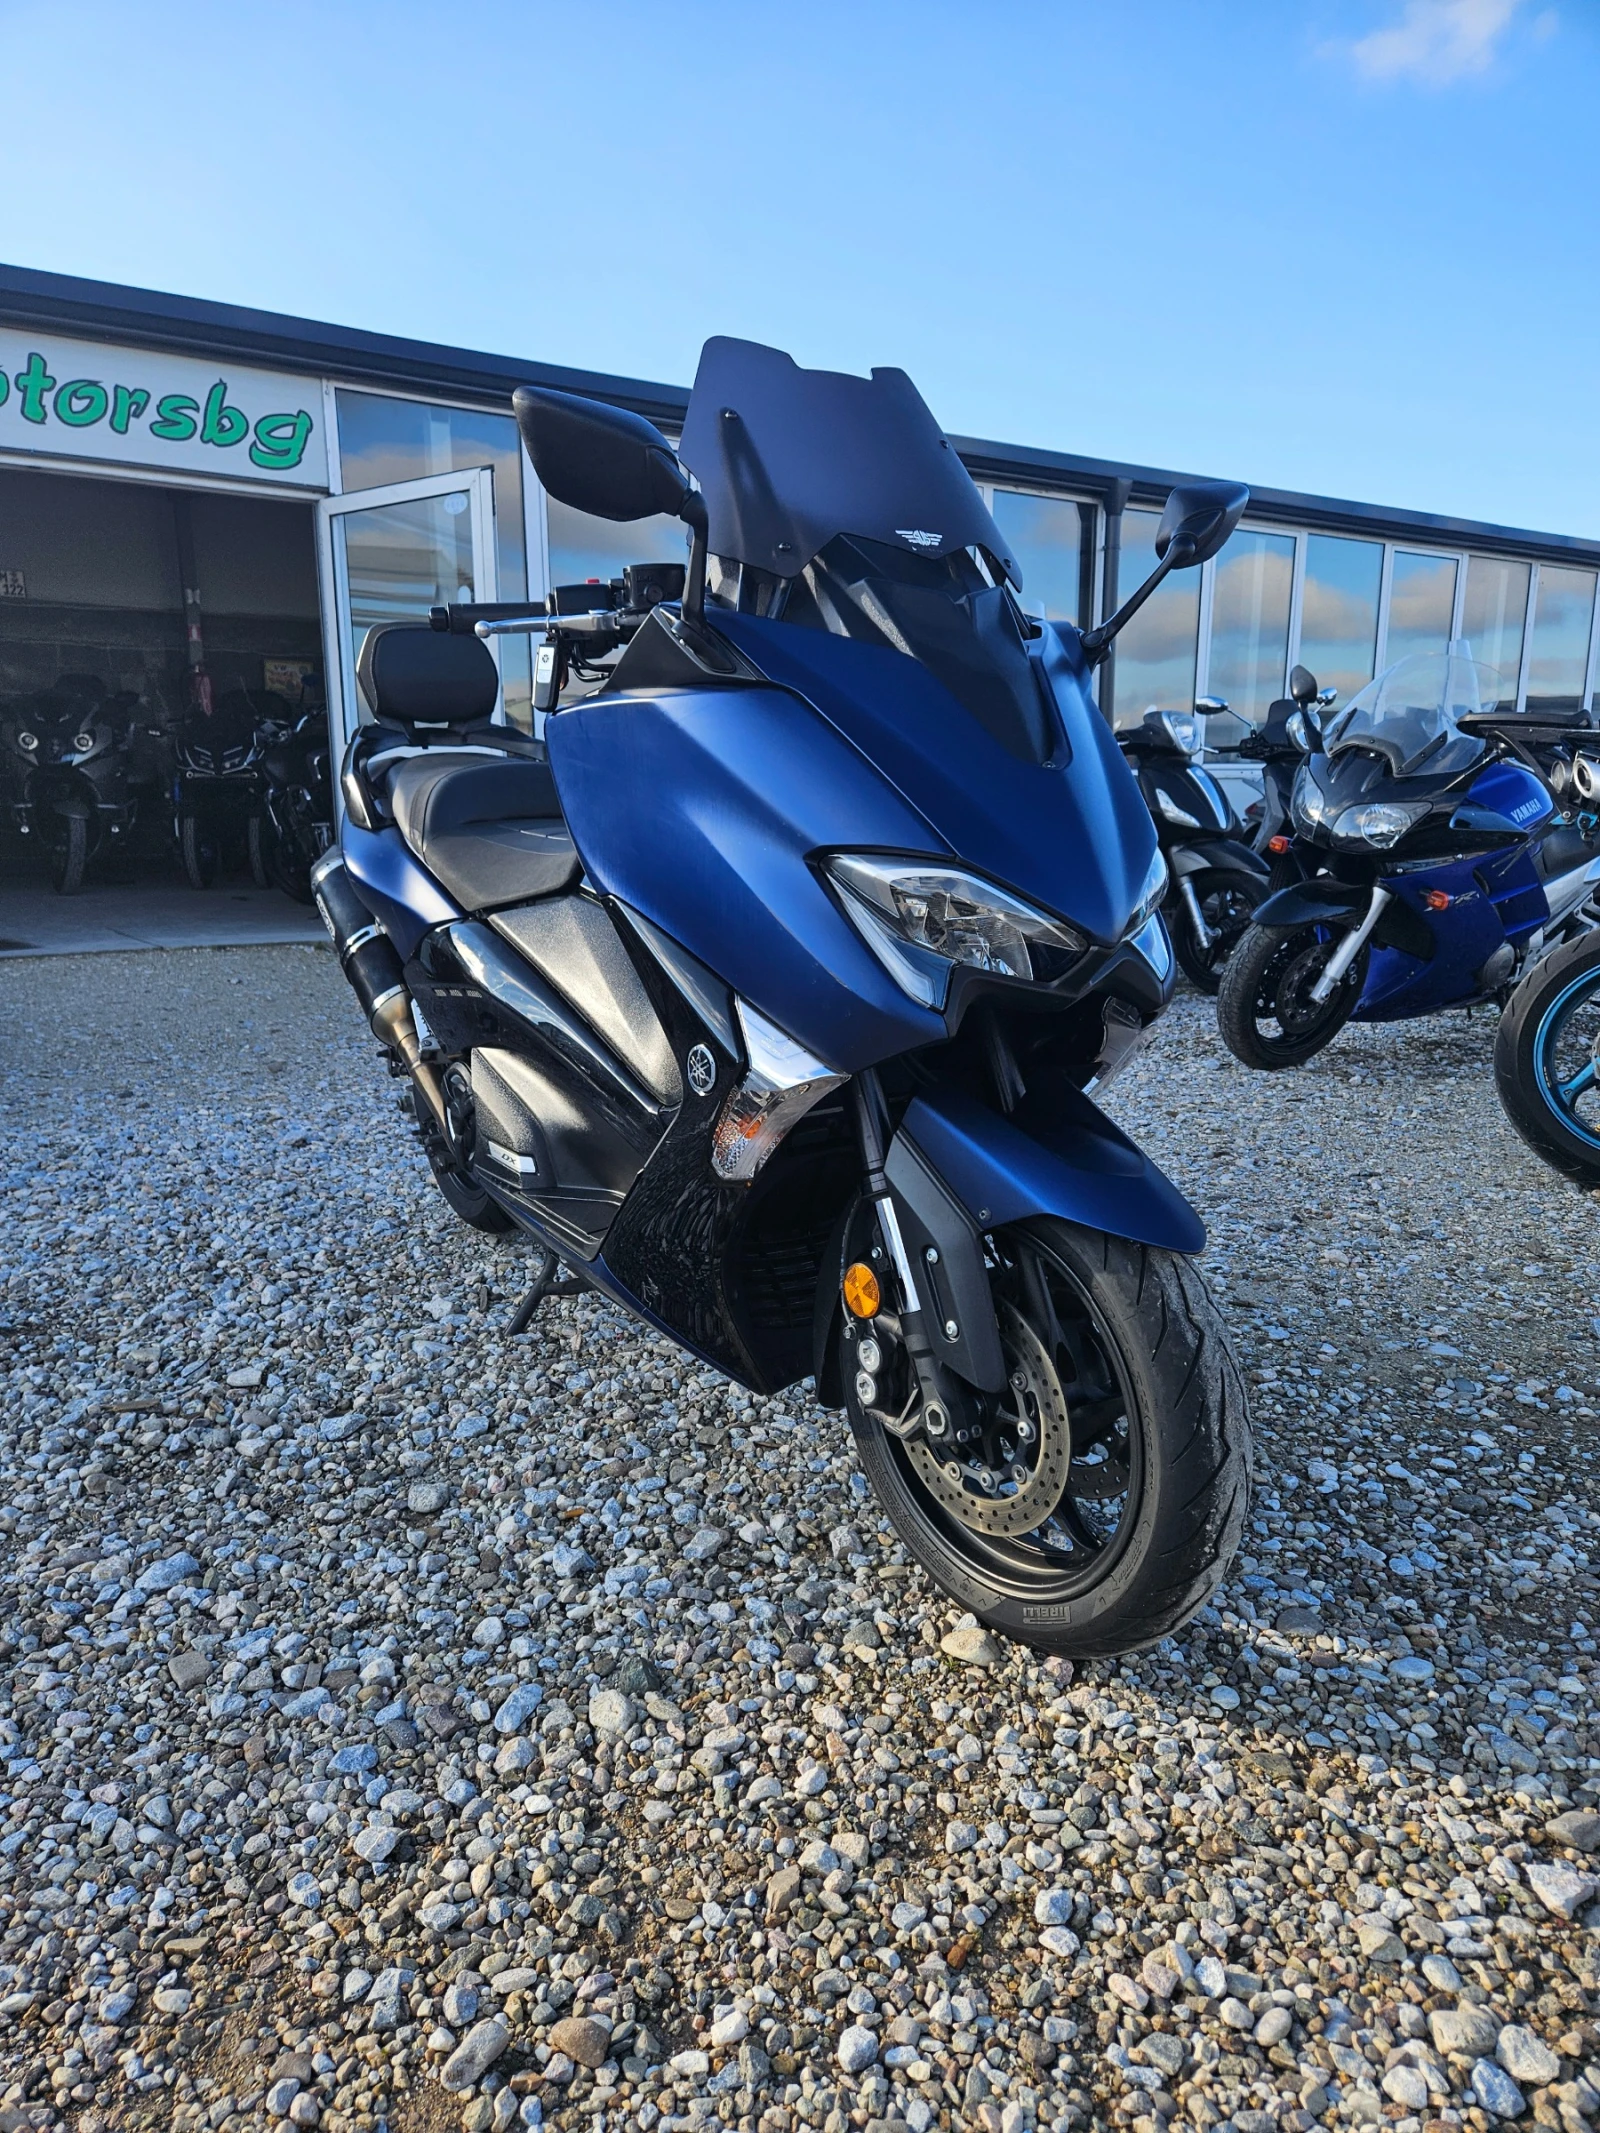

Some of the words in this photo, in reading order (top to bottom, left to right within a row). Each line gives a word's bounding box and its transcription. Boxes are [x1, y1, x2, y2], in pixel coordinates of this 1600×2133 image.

[0, 352, 313, 470] torsbg
[1510, 798, 1543, 823] YAMAHA
[501, 1153, 517, 1165] DX
[1023, 1606, 1071, 1624] PIRELLI
